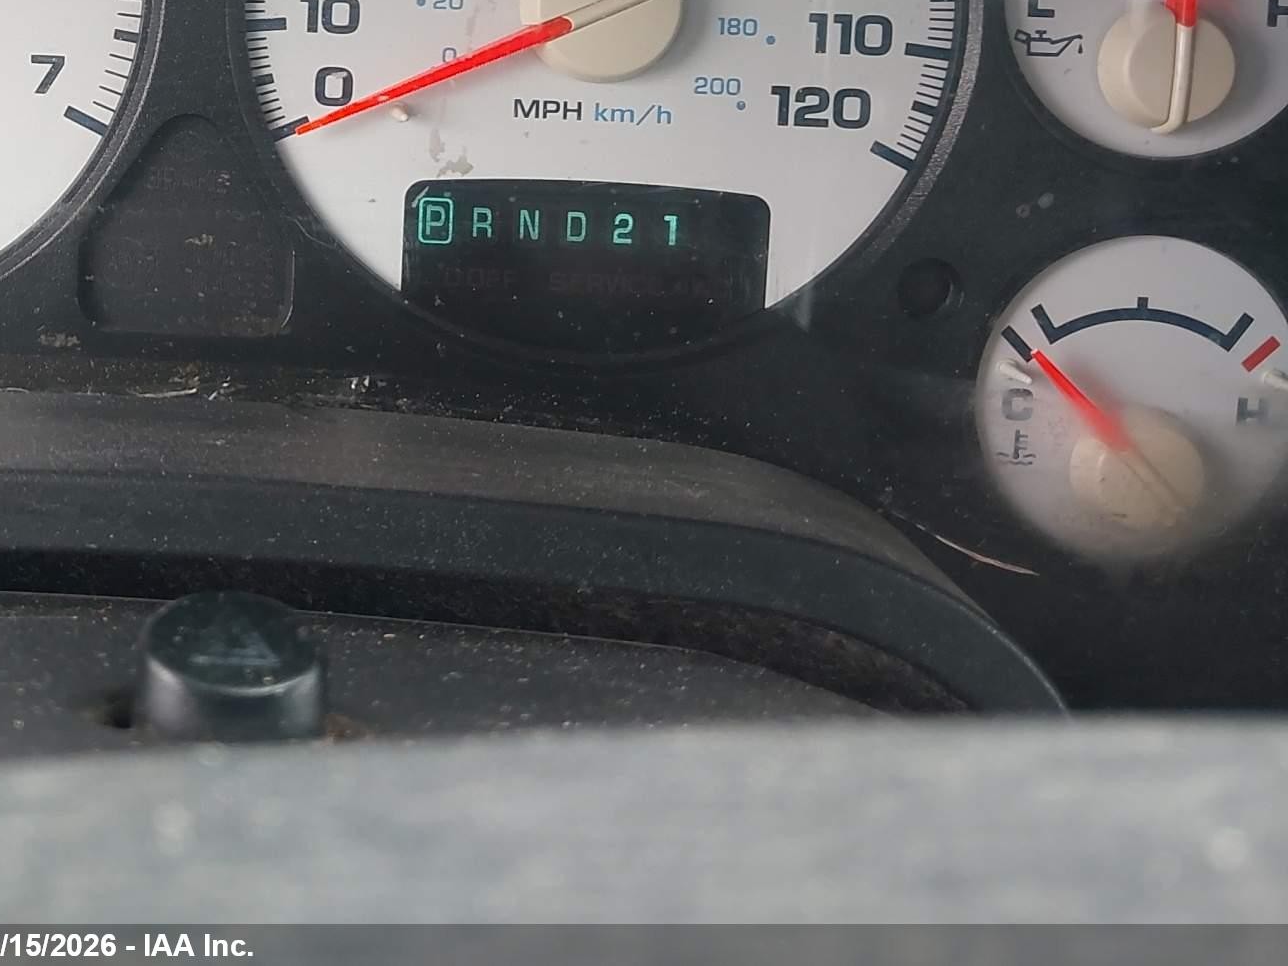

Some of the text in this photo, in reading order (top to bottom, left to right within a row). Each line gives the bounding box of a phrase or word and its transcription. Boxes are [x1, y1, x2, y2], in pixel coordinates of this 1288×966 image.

[718, 18, 757, 36] 180
[809, 13, 892, 56] 110
[31, 55, 65, 94] 7
[315, 67, 353, 105] 0
[694, 77, 740, 95] 200
[514, 99, 671, 125] MPH km/h
[771, 86, 871, 129] 120
[425, 204, 680, 246] P R N D 2 1
[1002, 388, 1033, 421] C
[1237, 398, 1268, 426] H
